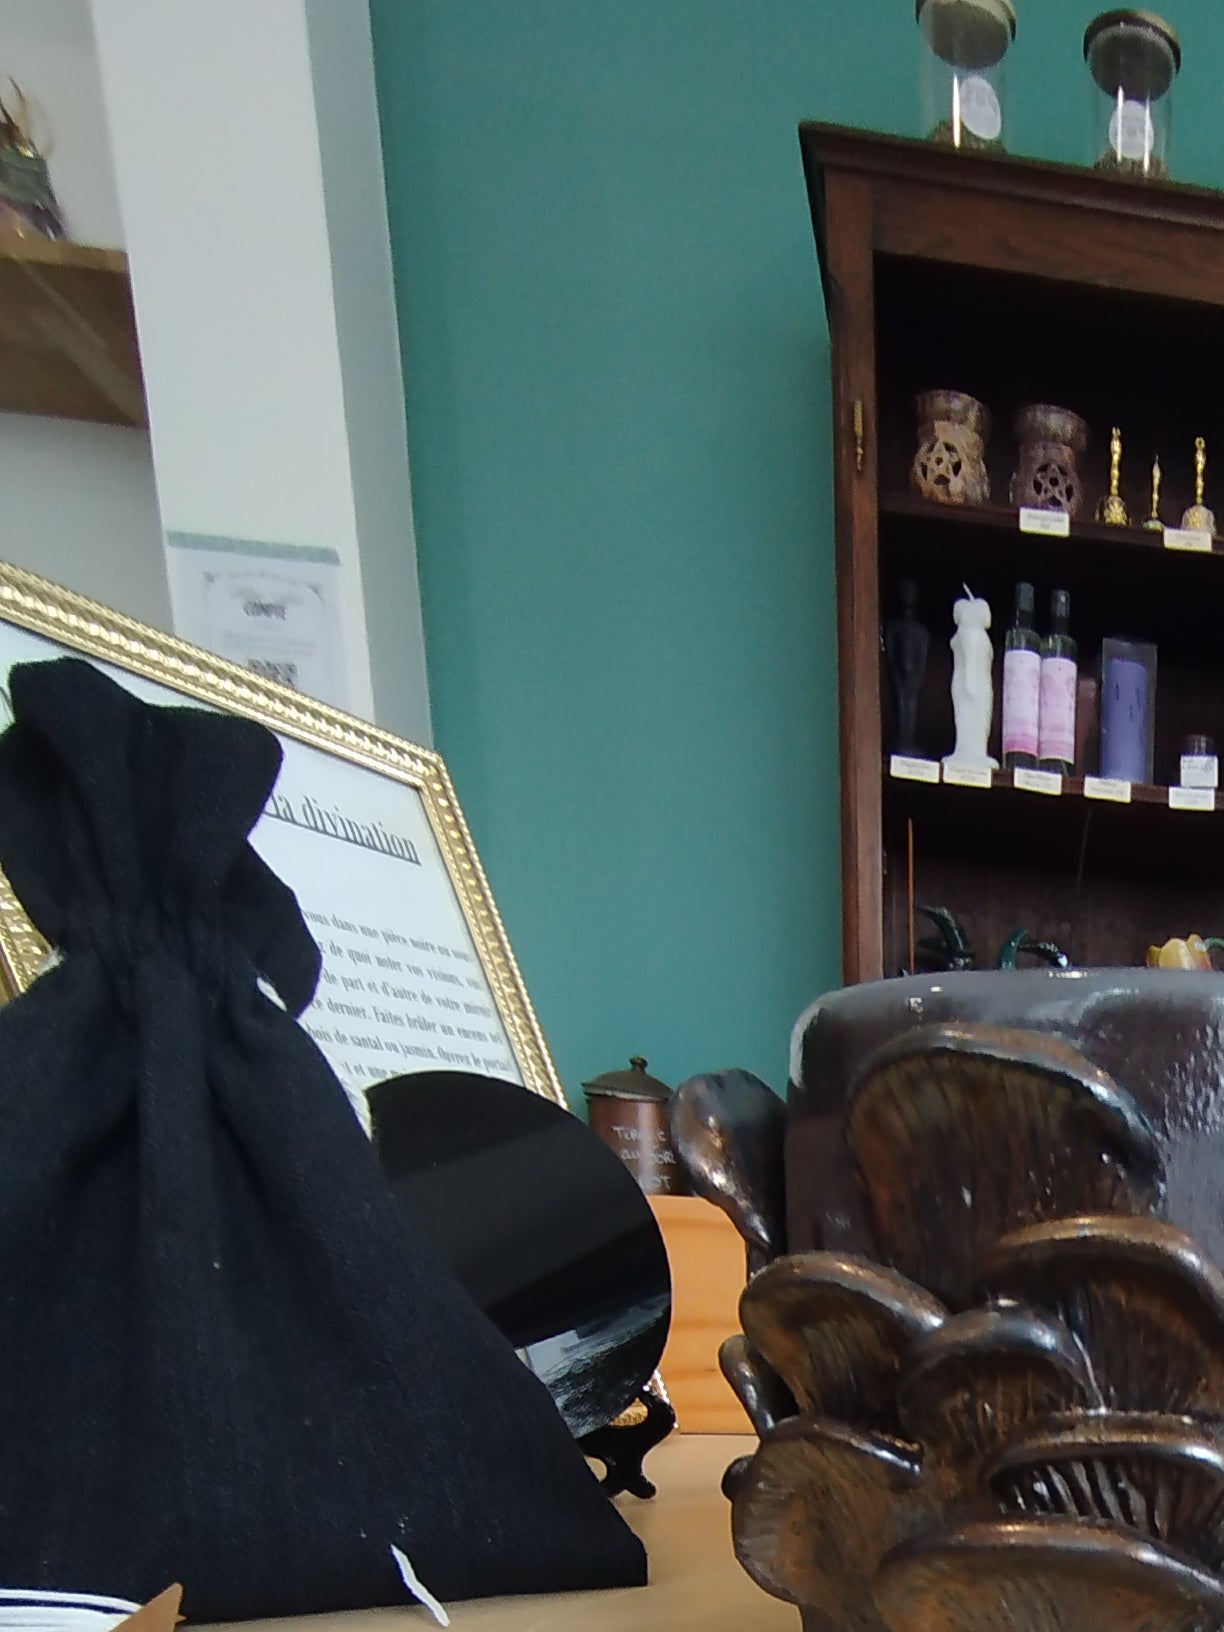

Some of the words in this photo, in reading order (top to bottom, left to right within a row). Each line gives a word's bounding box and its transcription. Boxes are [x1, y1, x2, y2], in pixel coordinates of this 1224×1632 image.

[303, 795, 421, 865] divination
[331, 914, 358, 934] dans
[359, 925, 379, 939] une
[329, 939, 343, 958] de
[347, 948, 372, 965] quoi
[375, 955, 403, 972] noter
[406, 964, 424, 977] vos
[341, 975, 366, 992] part
[367, 981, 380, 995] et
[421, 989, 433, 1005] de
[435, 997, 461, 1011] votre
[371, 1005, 405, 1027] Faites
[405, 1012, 437, 1034] brûler
[440, 1024, 455, 1036] un
[457, 1027, 489, 1042] encens
[335, 1027, 349, 1046] de
[349, 1035, 384, 1051] santal
[384, 1041, 400, 1054] ou
[437, 1045, 472, 1067] Ouvrez
